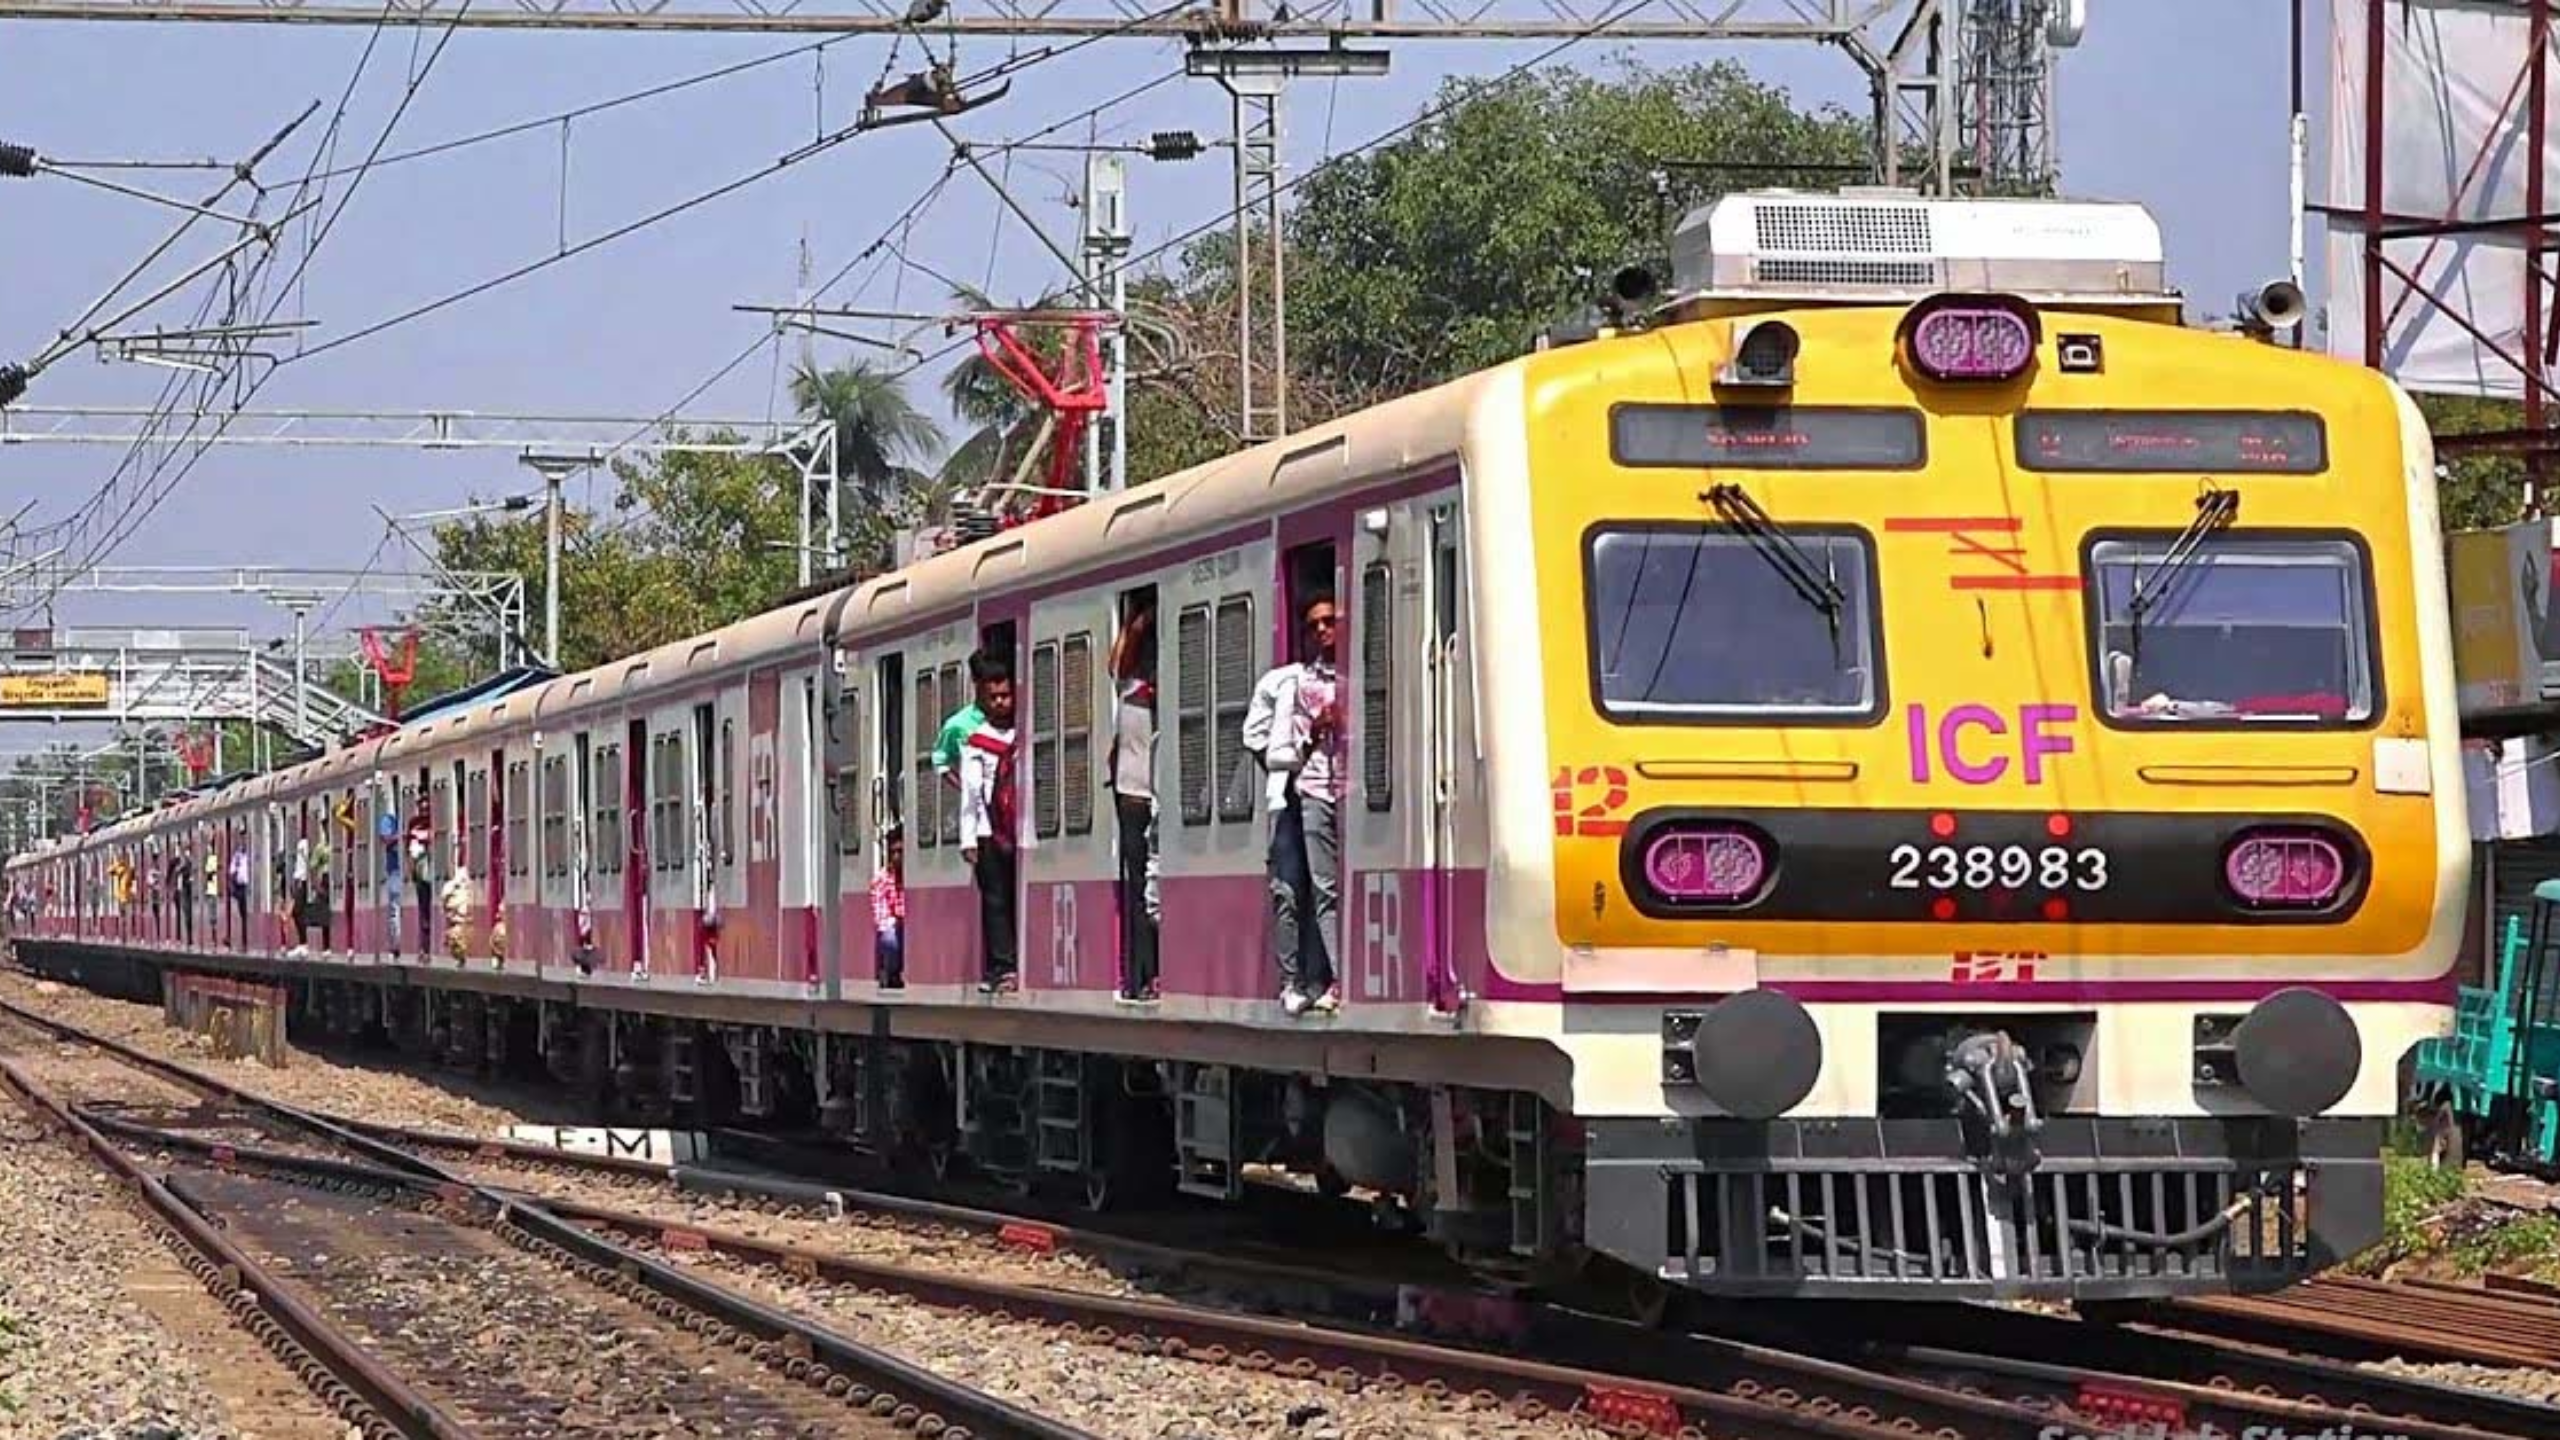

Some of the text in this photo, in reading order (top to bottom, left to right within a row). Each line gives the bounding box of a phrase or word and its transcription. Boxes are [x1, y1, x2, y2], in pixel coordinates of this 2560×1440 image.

[1907, 703, 2077, 785] ICF
[1550, 765, 1629, 836] 12
[1890, 843, 2108, 890] 238983
[1053, 884, 1078, 986] ER
[1364, 873, 1403, 998] ER
